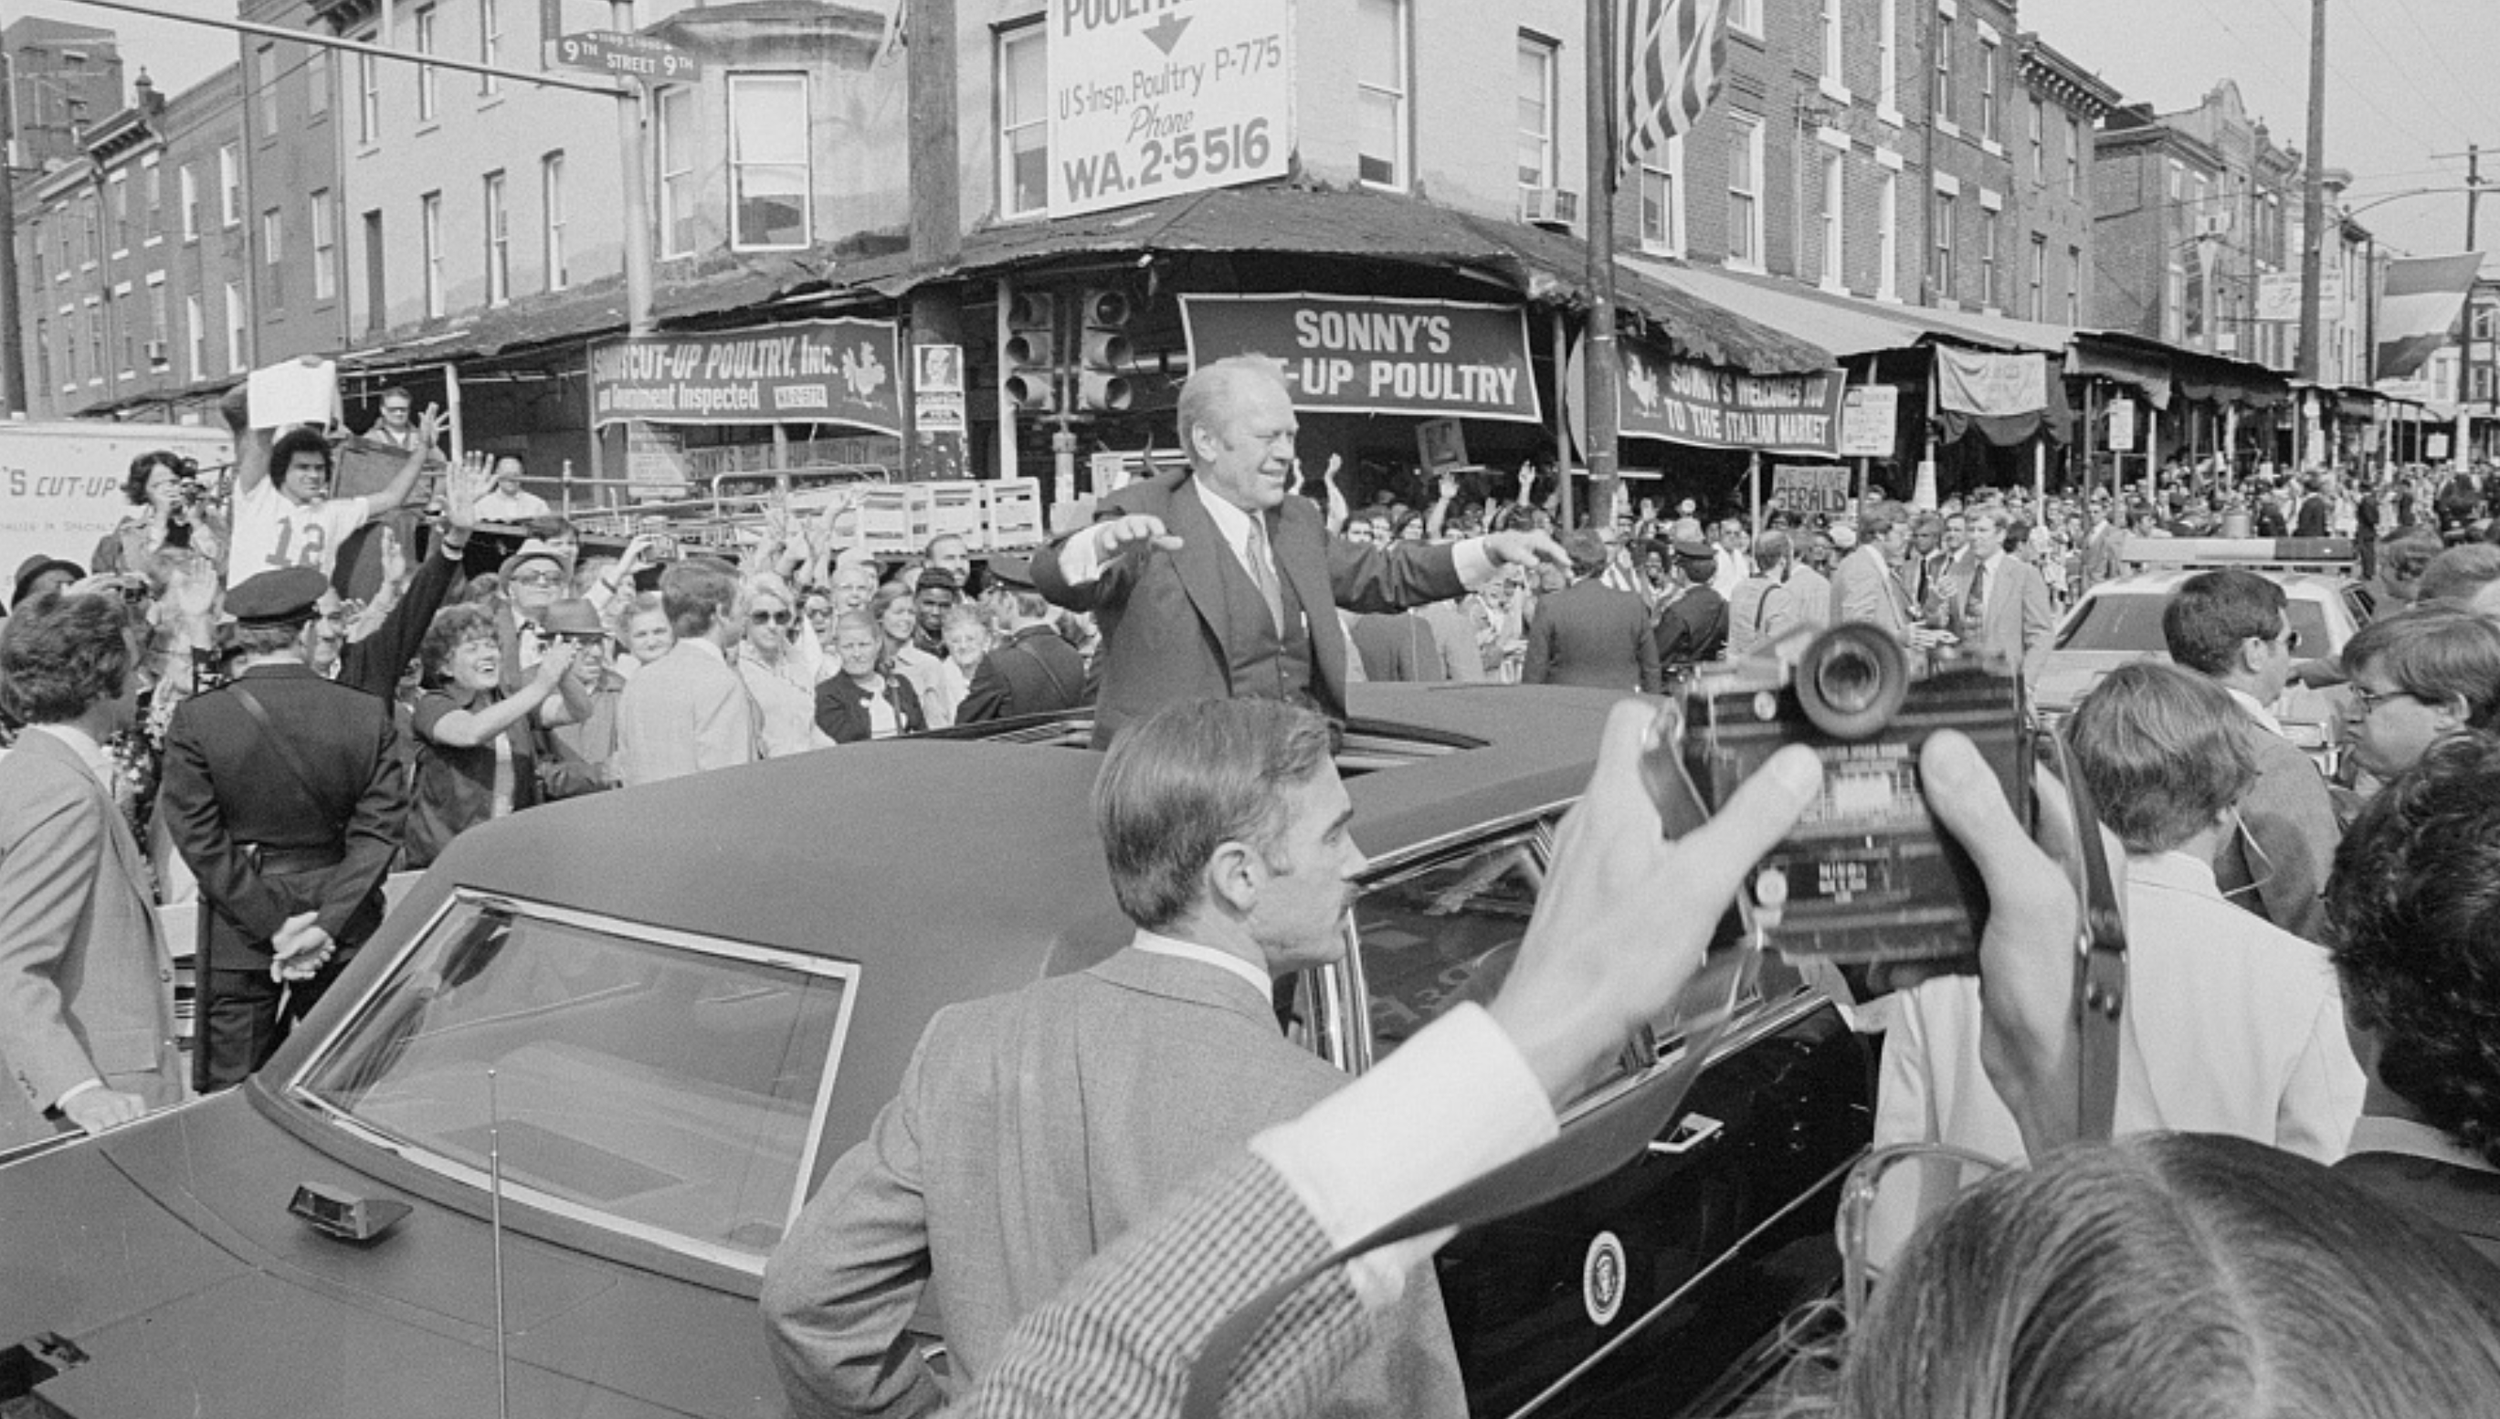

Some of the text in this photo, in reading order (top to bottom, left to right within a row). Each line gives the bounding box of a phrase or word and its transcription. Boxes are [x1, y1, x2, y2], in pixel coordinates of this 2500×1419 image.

[606, 52, 655, 74] STREET
[1132, 62, 1206, 103] Poultry
[1215, 34, 1281, 81] P-775
[1126, 103, 1194, 144] Phone
[1295, 308, 1451, 354] SONNY'S
[630, 343, 703, 380] CUT-UP
[1369, 359, 1518, 405] POULTRY
[679, 380, 760, 416] Inspected
[1670, 362, 1733, 405] SONNYS
[1663, 397, 1687, 433] TO
[1686, 401, 1722, 439] THE
[35, 475, 118, 498] CUT-UP
[265, 515, 326, 568] 12
